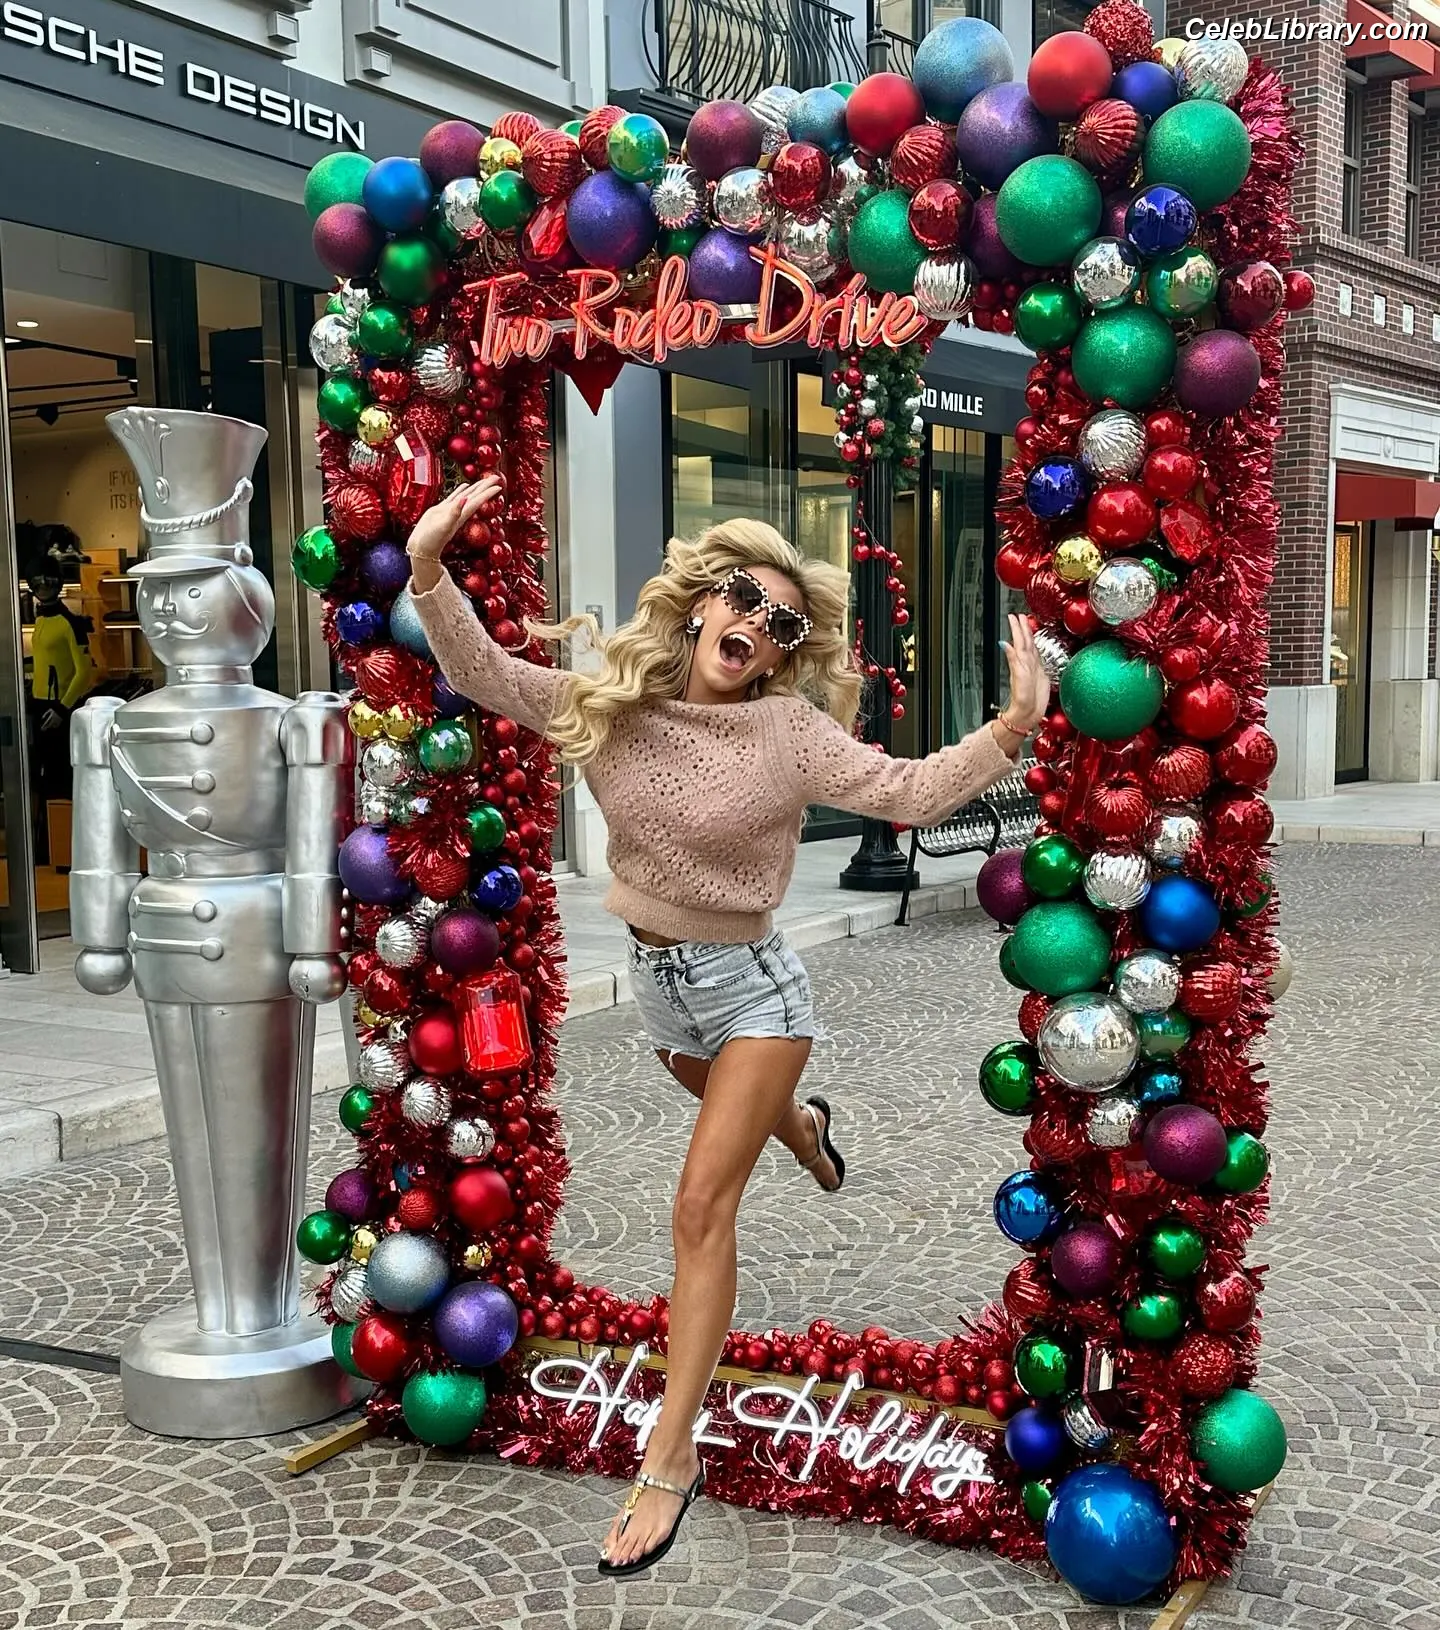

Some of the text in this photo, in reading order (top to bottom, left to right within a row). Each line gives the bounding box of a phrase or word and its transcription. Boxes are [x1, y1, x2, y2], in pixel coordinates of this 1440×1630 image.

[3, 1, 365, 150] SCHE DESIGN
[463, 242, 928, 368] Two Rodeo Drive
[940, 390, 983, 416] MILLE
[109, 470, 119, 486] IF
[110, 494, 127, 510] ITS
[733, 1373, 995, 1498] Holidays
